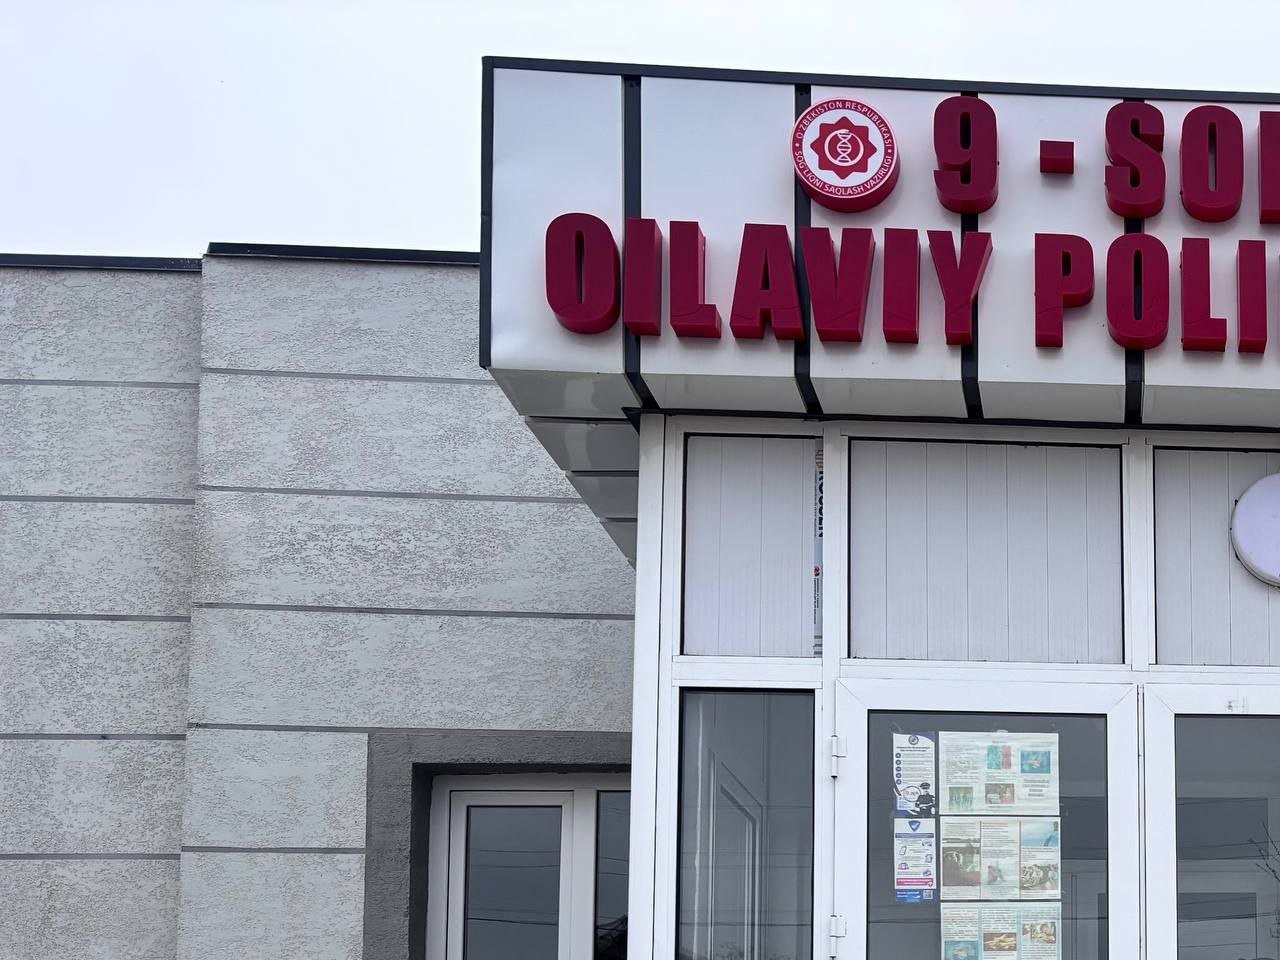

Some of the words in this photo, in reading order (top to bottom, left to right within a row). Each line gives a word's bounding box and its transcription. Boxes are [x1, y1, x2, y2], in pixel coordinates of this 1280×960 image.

[845, 101, 893, 147] RESPUBLIKASI
[934, 96, 999, 213] 9
[824, 184, 864, 195] SAQLASH
[864, 156, 893, 189] VAZIRLIGI
[545, 212, 992, 346] OILAVIY
